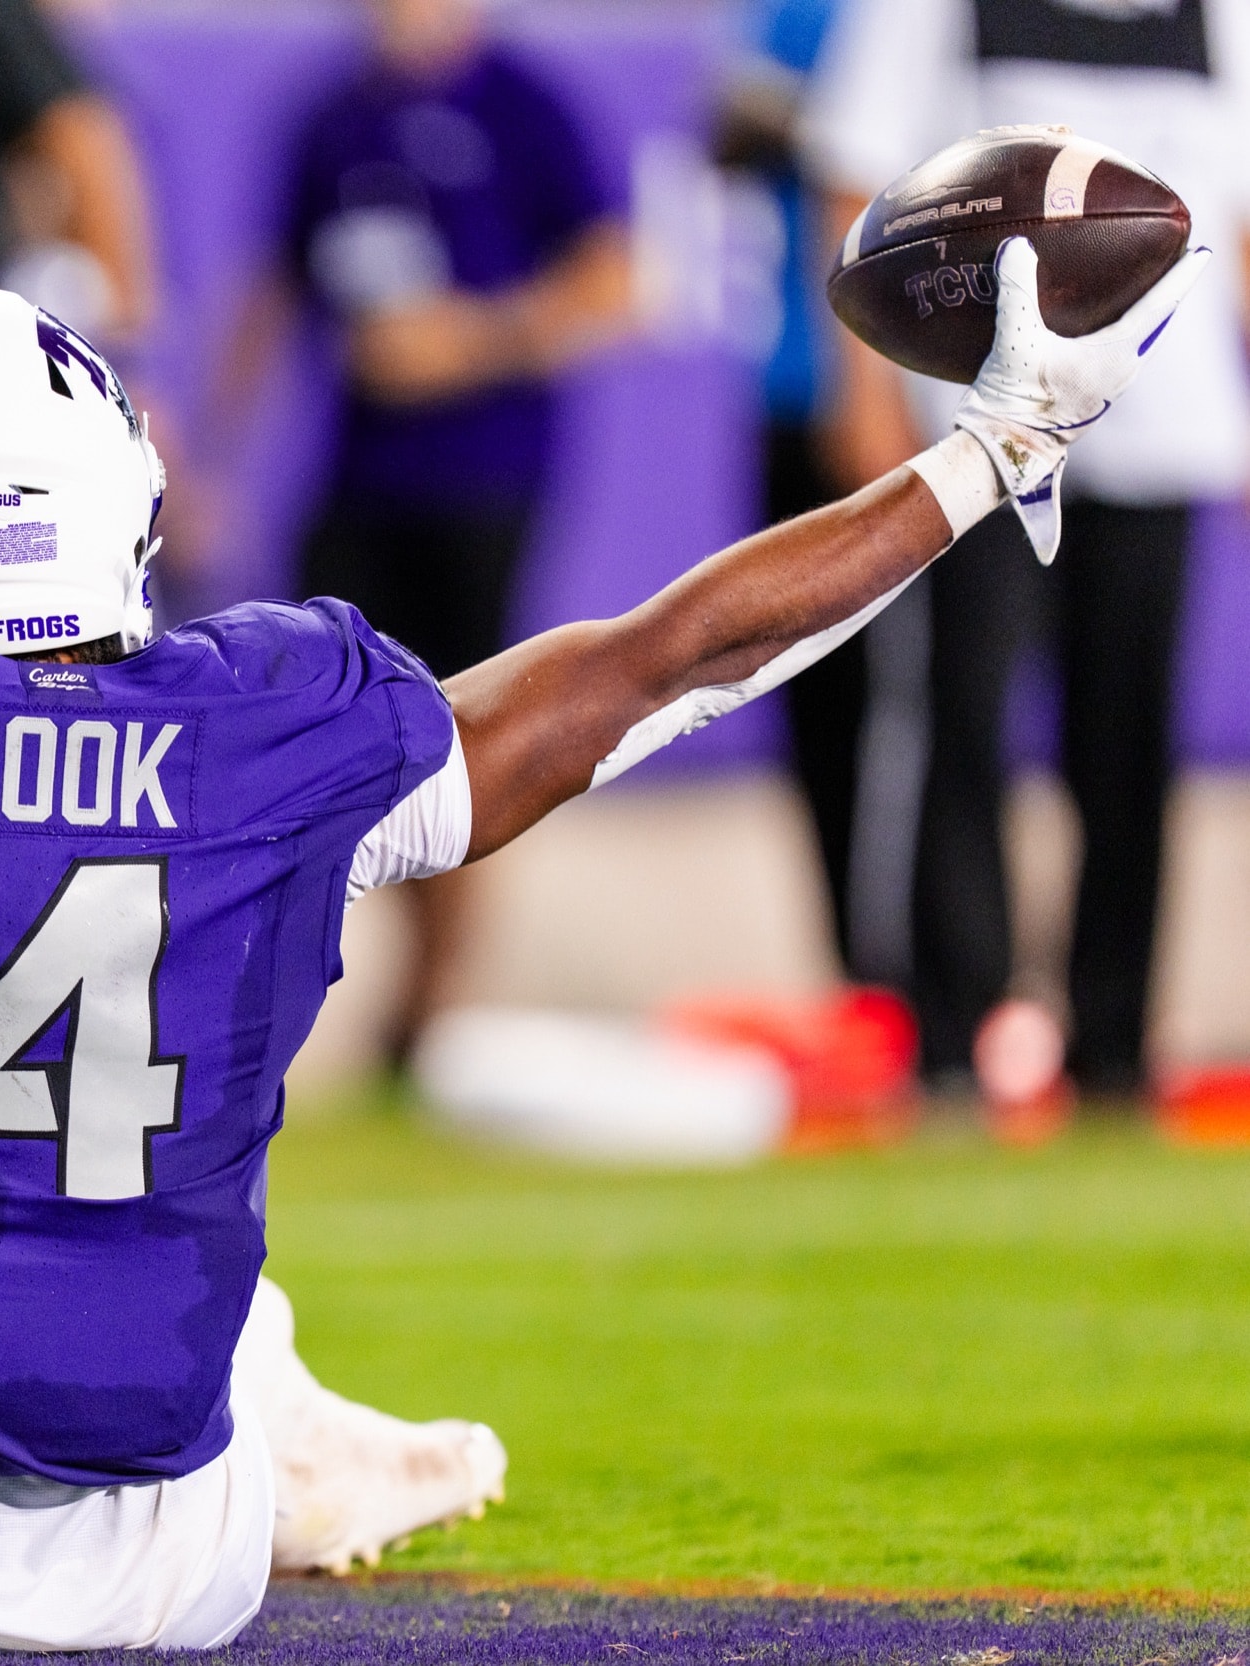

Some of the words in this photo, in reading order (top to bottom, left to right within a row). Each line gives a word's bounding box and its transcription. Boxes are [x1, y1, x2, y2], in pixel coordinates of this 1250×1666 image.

[883, 208, 940, 236] VAPOR
[940, 197, 1003, 218] ELITE
[934, 240, 948, 261] 7
[904, 263, 999, 320] TCU
[29, 667, 88, 683] Carter
